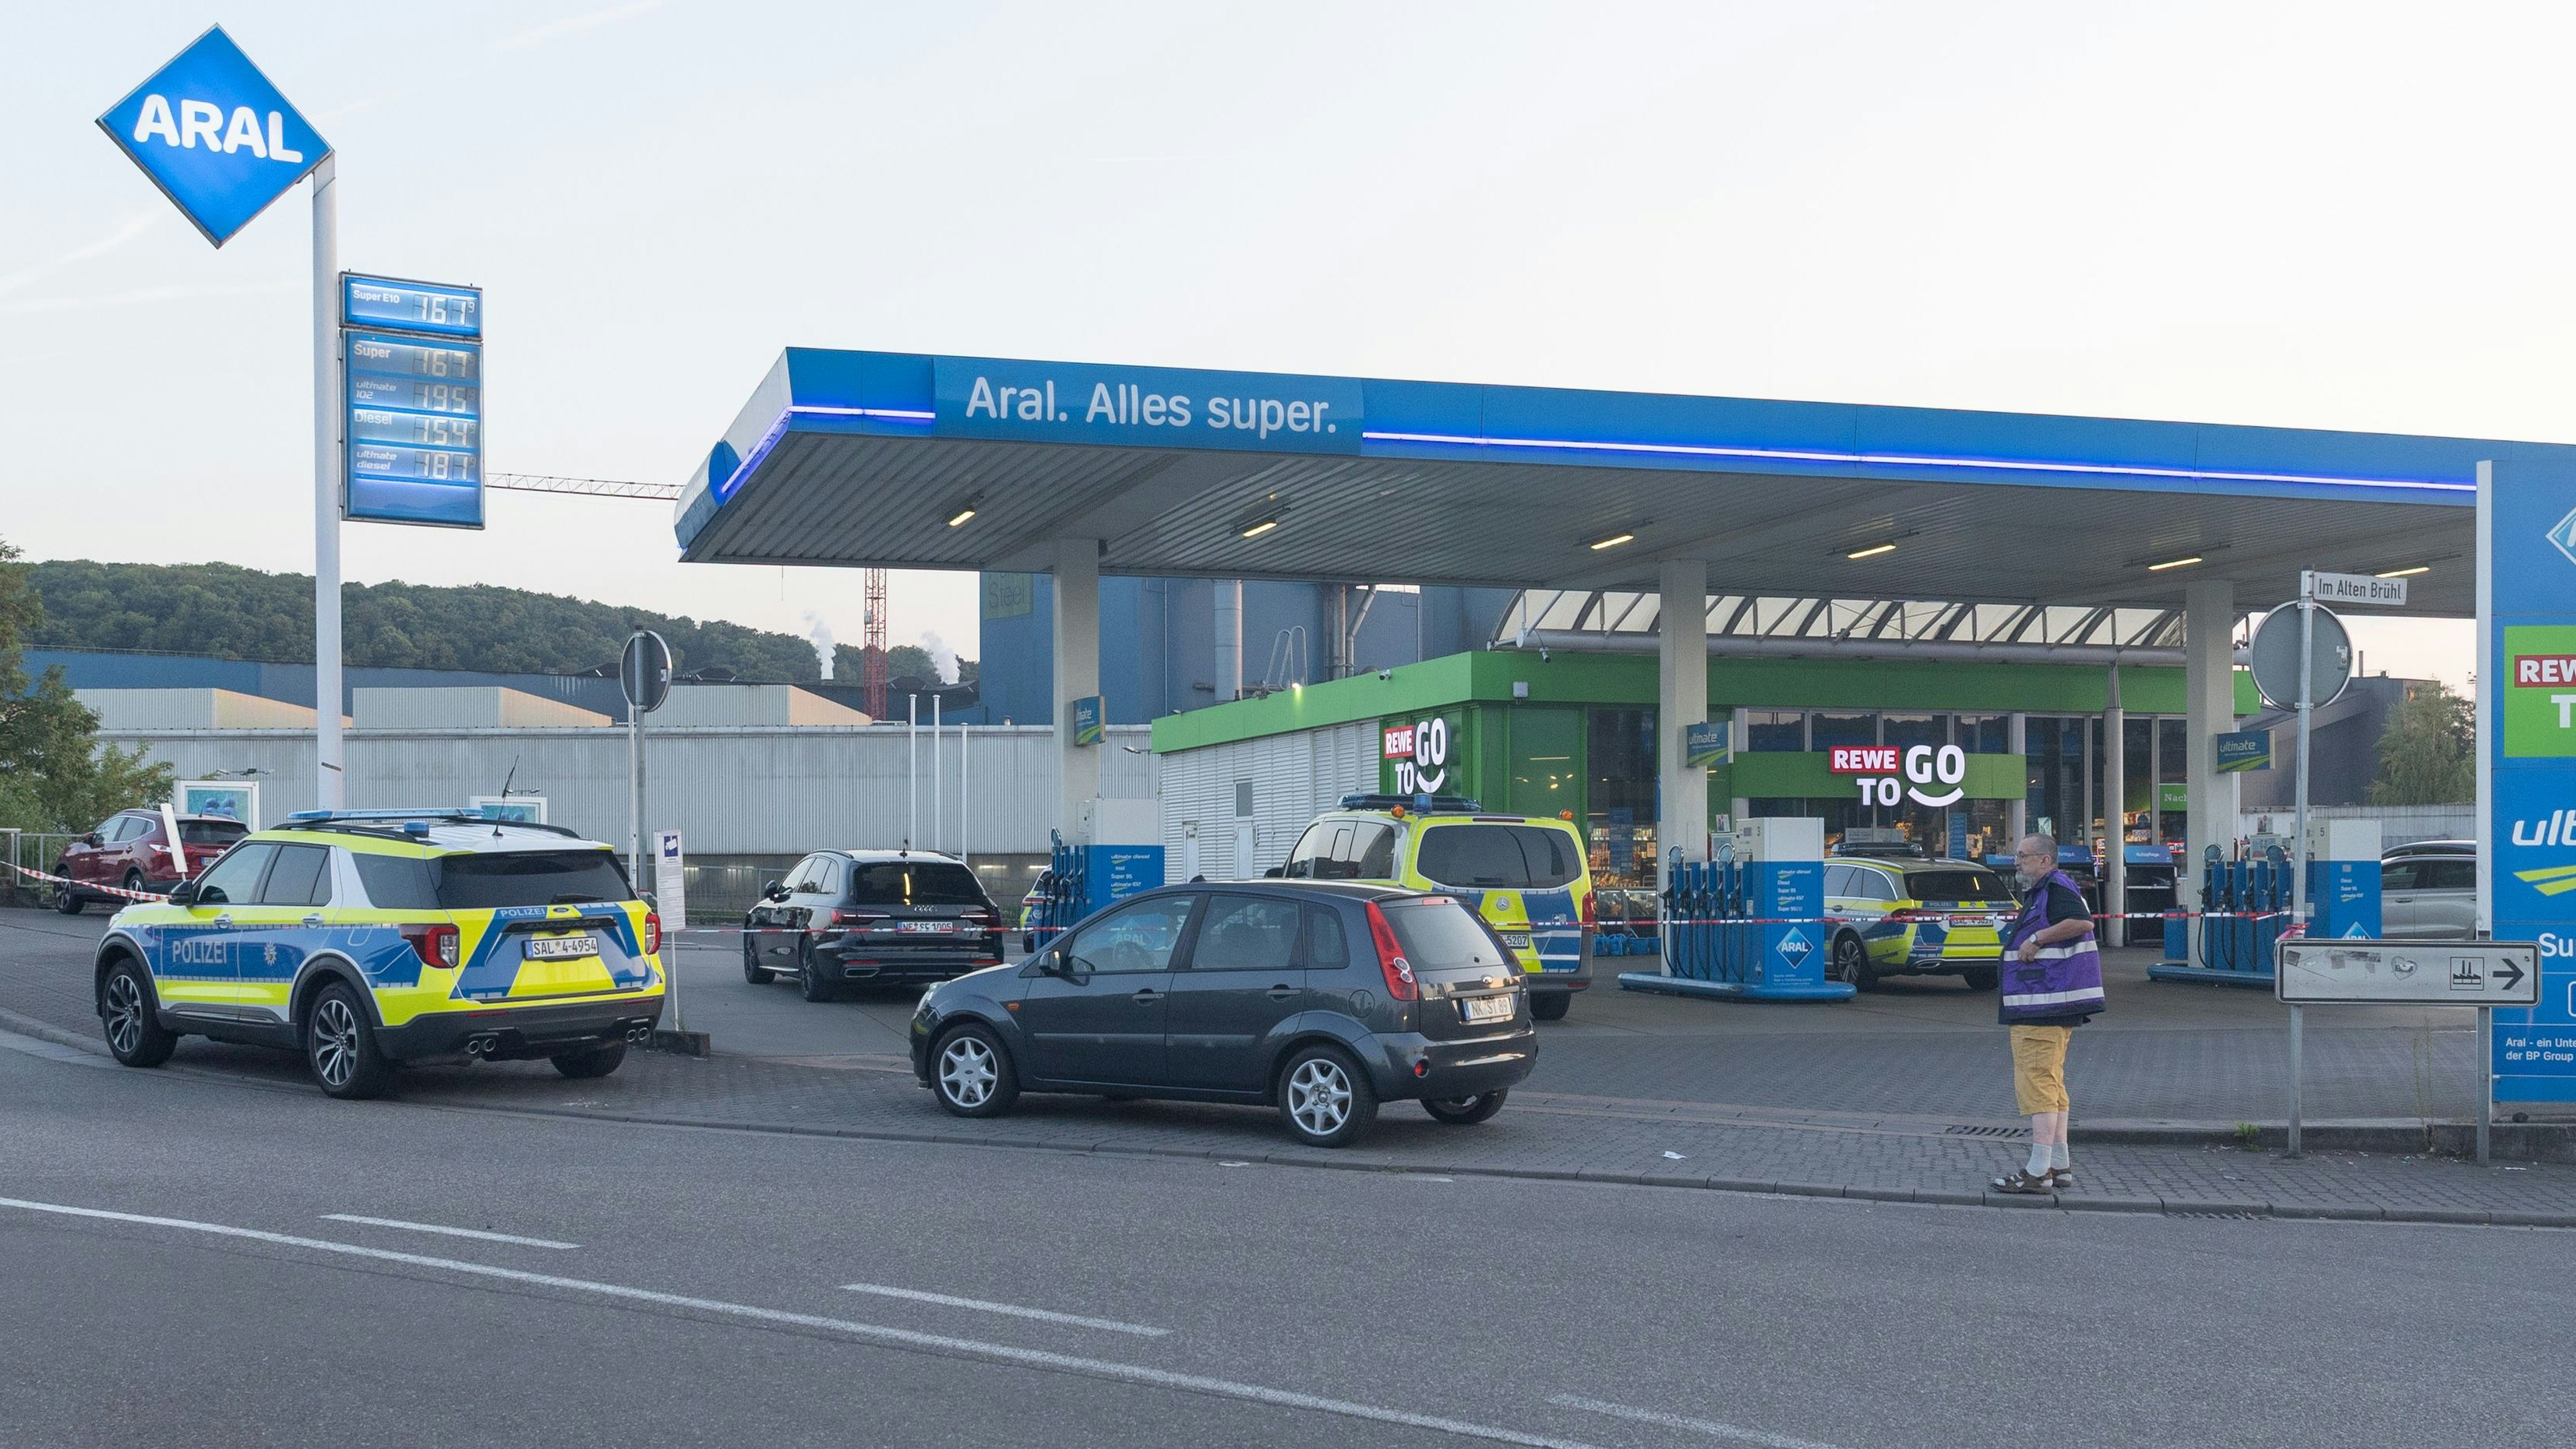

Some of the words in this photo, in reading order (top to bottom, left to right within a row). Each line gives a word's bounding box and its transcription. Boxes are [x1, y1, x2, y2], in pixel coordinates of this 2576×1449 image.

[133, 93, 303, 164] ARAL
[353, 290, 382, 301] Super
[383, 295, 400, 304] E10
[354, 344, 391, 359] Super
[356, 381, 397, 392] ultimate
[356, 390, 373, 400] 102
[966, 376, 1067, 422] Aral.
[1086, 383, 1191, 427] Alles
[1208, 397, 1336, 439] super.
[354, 411, 393, 425] Diesel
[357, 450, 397, 461] ultimate
[356, 462, 390, 471] diesel
[2319, 578, 2333, 595] Im
[2337, 580, 2366, 598] Alten
[2370, 581, 2401, 600] Brühl
[1385, 729, 1413, 755] REWE
[1416, 717, 1446, 767] GO
[1689, 729, 1717, 745] ultimate
[2220, 739, 2256, 753] ultimate
[1834, 749, 1897, 770] REWE
[1905, 744, 1965, 784] GO
[1395, 761, 1414, 795] TO
[1856, 777, 1901, 807] TO
[2320, 827, 2325, 837] 5
[499, 908, 545, 917] POLIZEI
[172, 940, 228, 964] POLIZEI
[534, 941, 555, 955] SAL
[563, 940, 597, 953] 4-4954
[1781, 942, 1808, 953] ARAL
[2539, 933, 2576, 957] Su
[2506, 1038, 2526, 1047] Aral
[2536, 1038, 2552, 1047] ein
[2506, 1052, 2523, 1060] der
[2526, 1052, 2540, 1060] BP
[2543, 1052, 2574, 1062] Group
